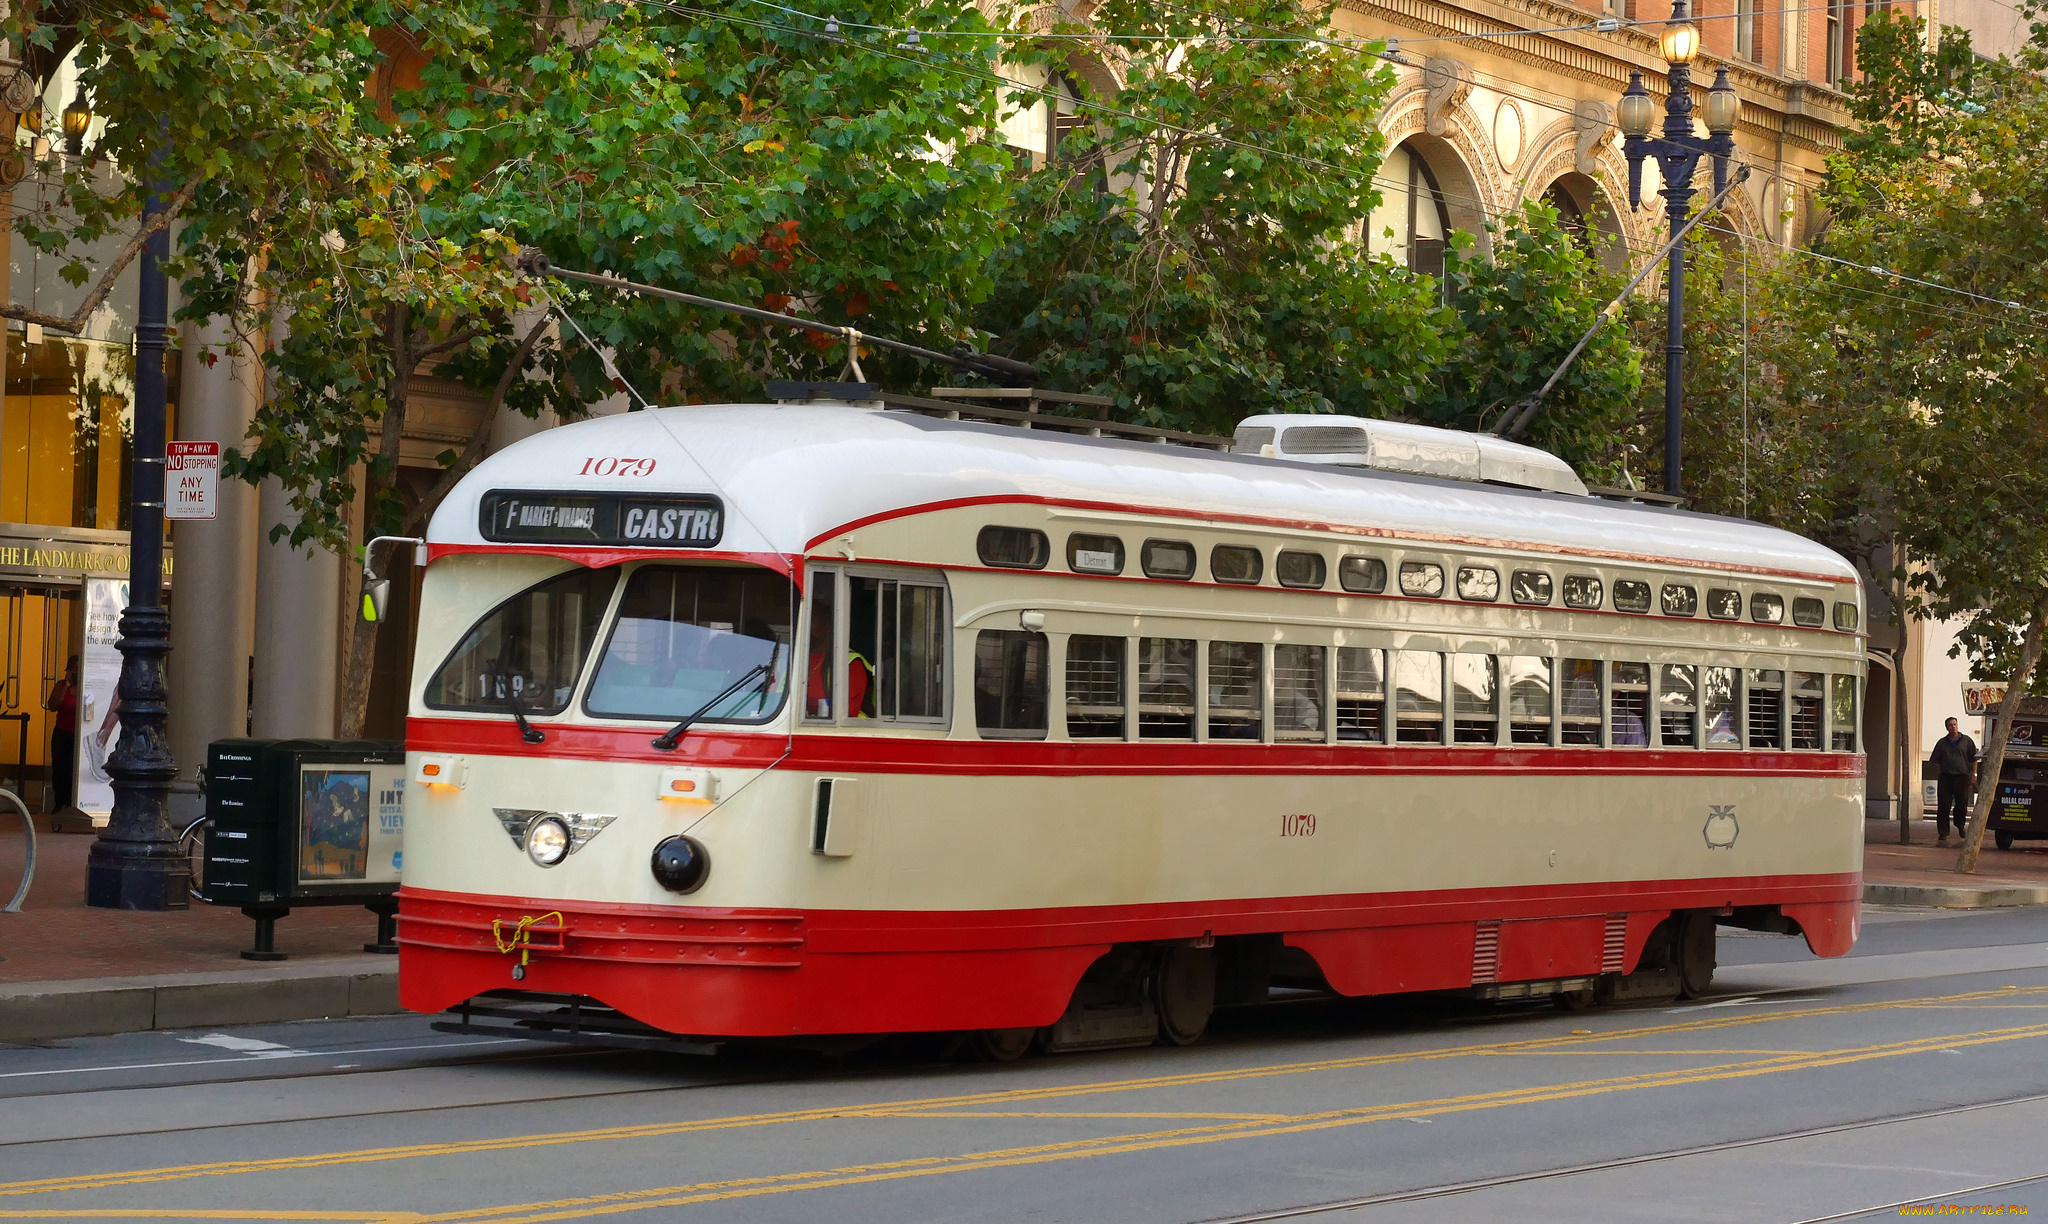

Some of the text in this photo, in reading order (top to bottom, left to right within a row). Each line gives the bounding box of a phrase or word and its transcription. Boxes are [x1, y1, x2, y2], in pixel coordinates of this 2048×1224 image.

[174, 444, 212, 454] TOW-AWAY
[167, 455, 217, 469] NO STOPPING
[576, 457, 657, 477] 1079
[180, 476, 203, 488] ANY
[178, 490, 204, 502] TIME
[505, 500, 520, 529] F
[519, 506, 556, 527] MARKET
[0, 547, 20, 566] HE
[23, 548, 103, 571] LANDMARK
[103, 611, 119, 622] how
[88, 623, 111, 636] design
[87, 635, 99, 645] the
[1280, 814, 1316, 837] 1079
